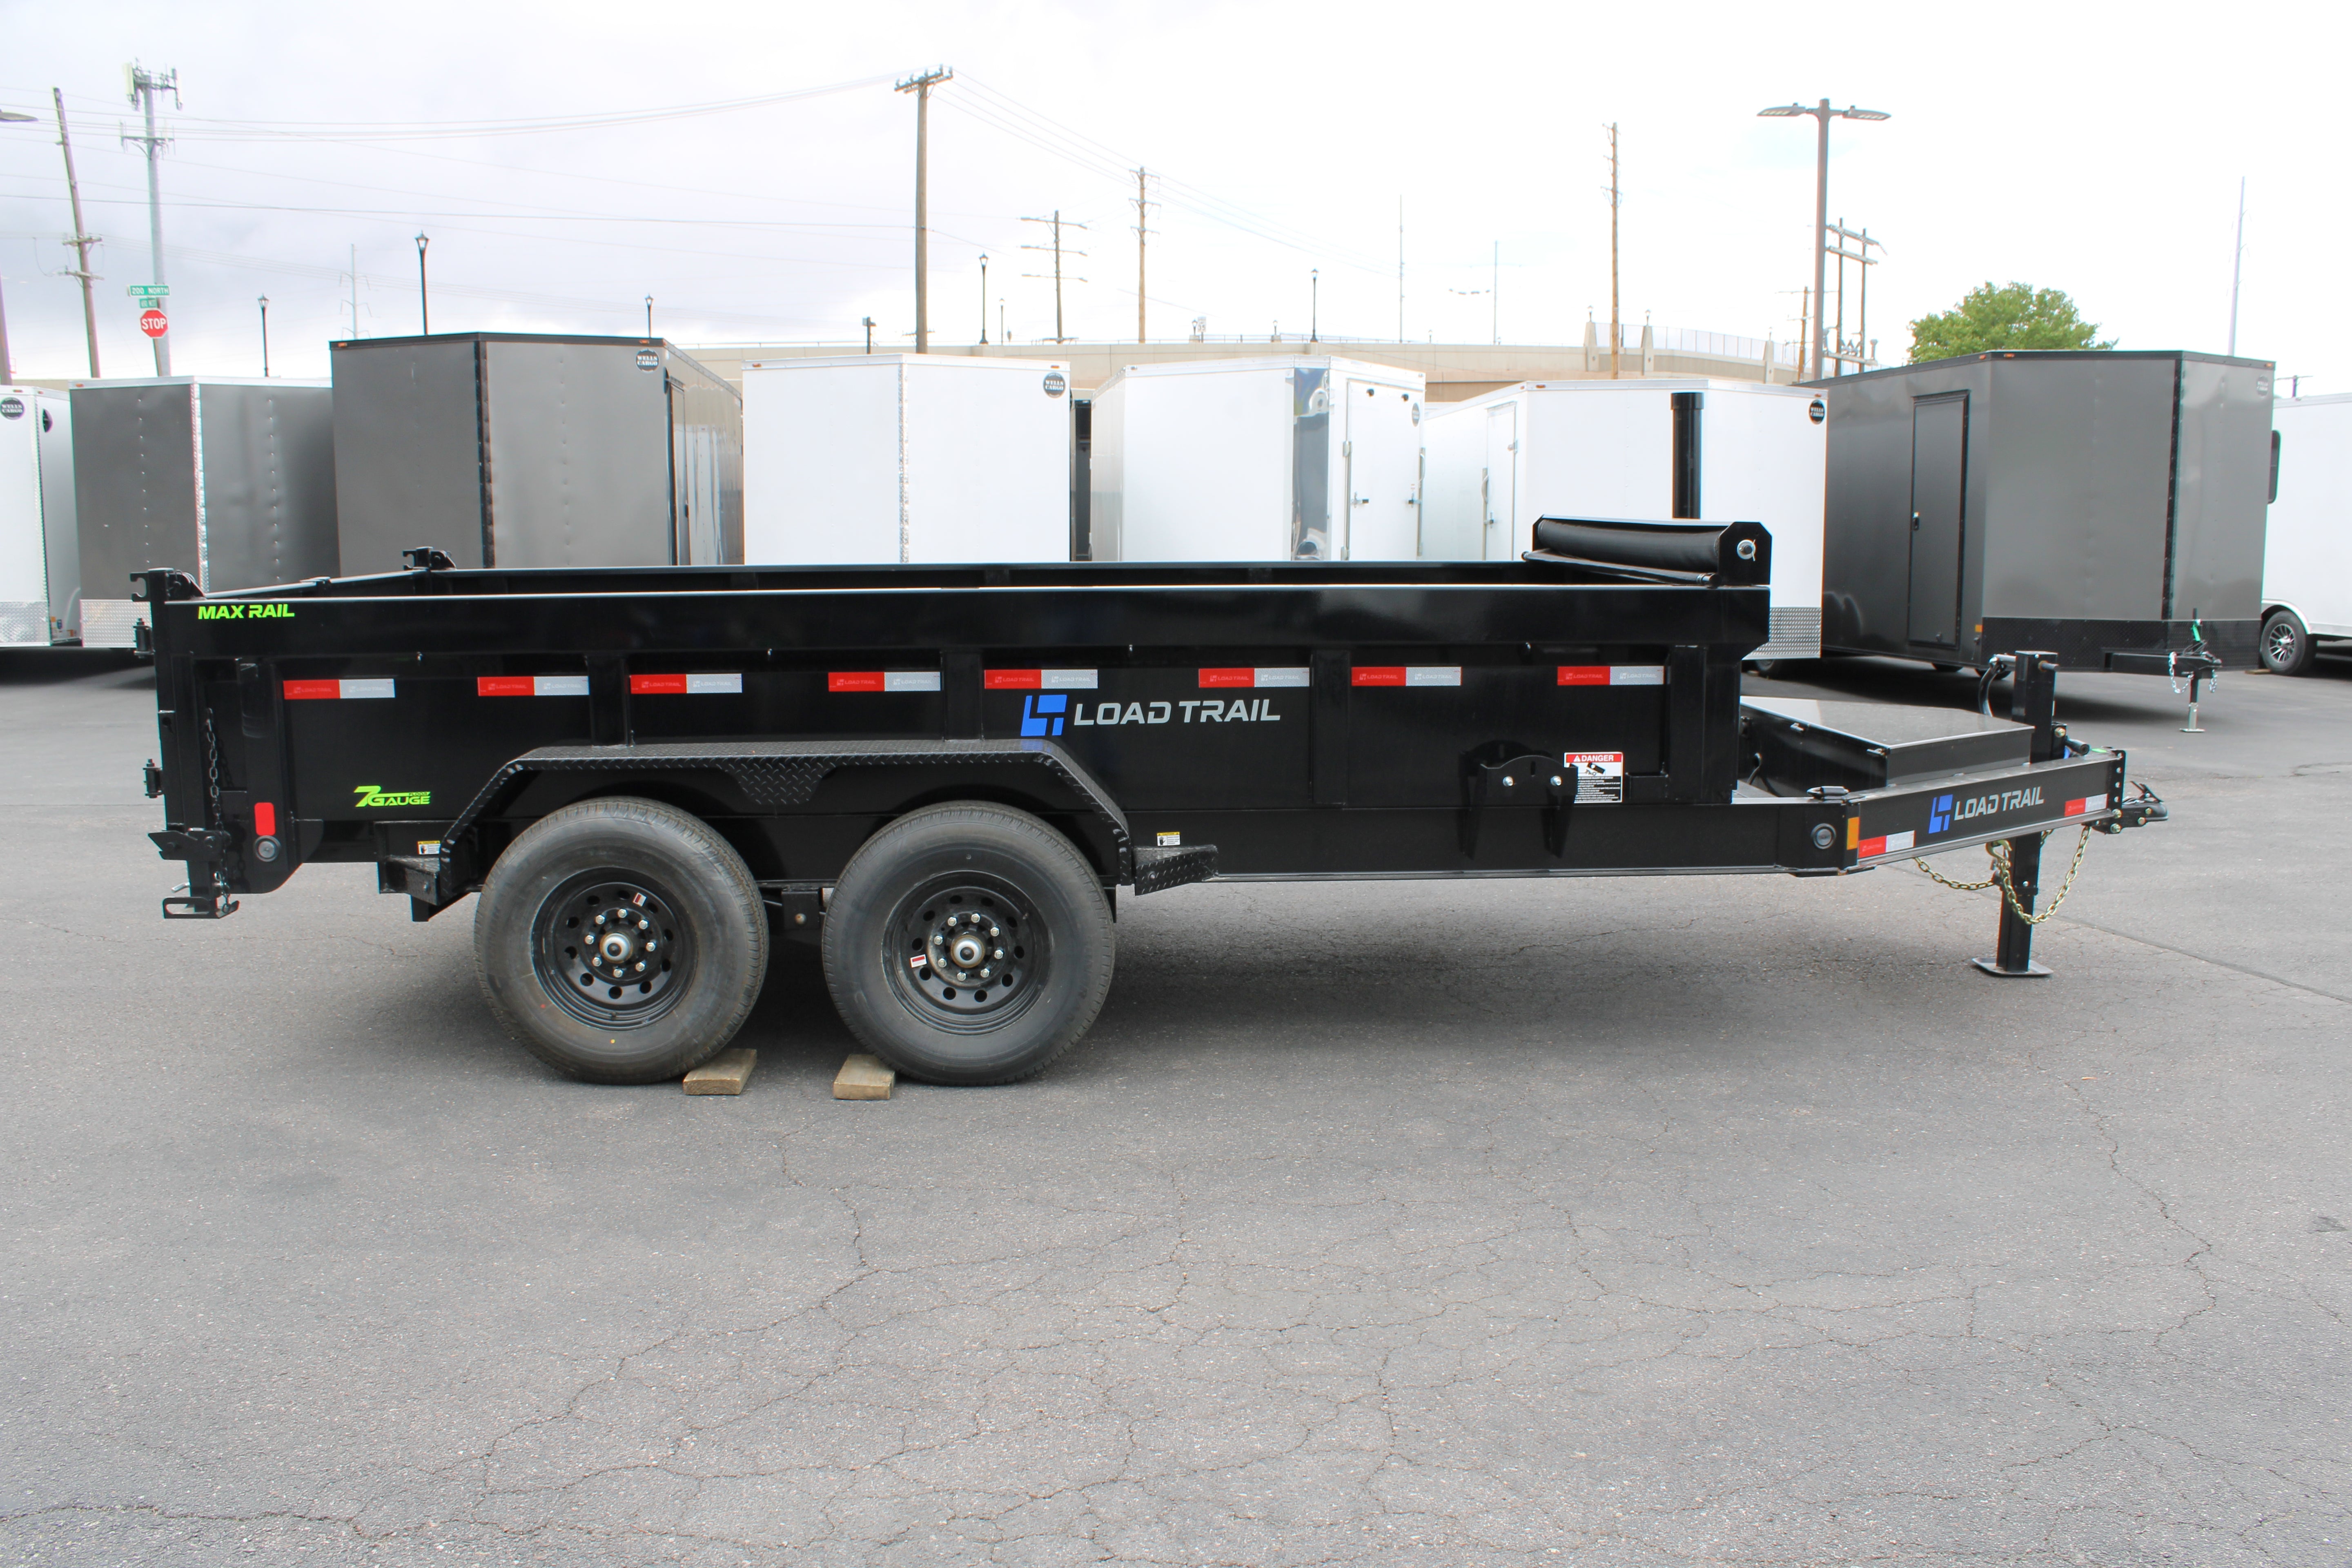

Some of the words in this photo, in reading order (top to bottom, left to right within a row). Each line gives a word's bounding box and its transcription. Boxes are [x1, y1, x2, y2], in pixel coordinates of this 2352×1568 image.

[141, 318, 166, 330] STOP
[198, 605, 245, 619] MAX
[248, 604, 295, 618] RAIL
[1074, 701, 1172, 726] LOAD
[1178, 699, 1281, 722] TRAIL
[354, 785, 381, 807] 7
[368, 794, 431, 806] GAUGE
[1953, 794, 2000, 821] LOAD
[2001, 786, 2045, 811] TRAIL
